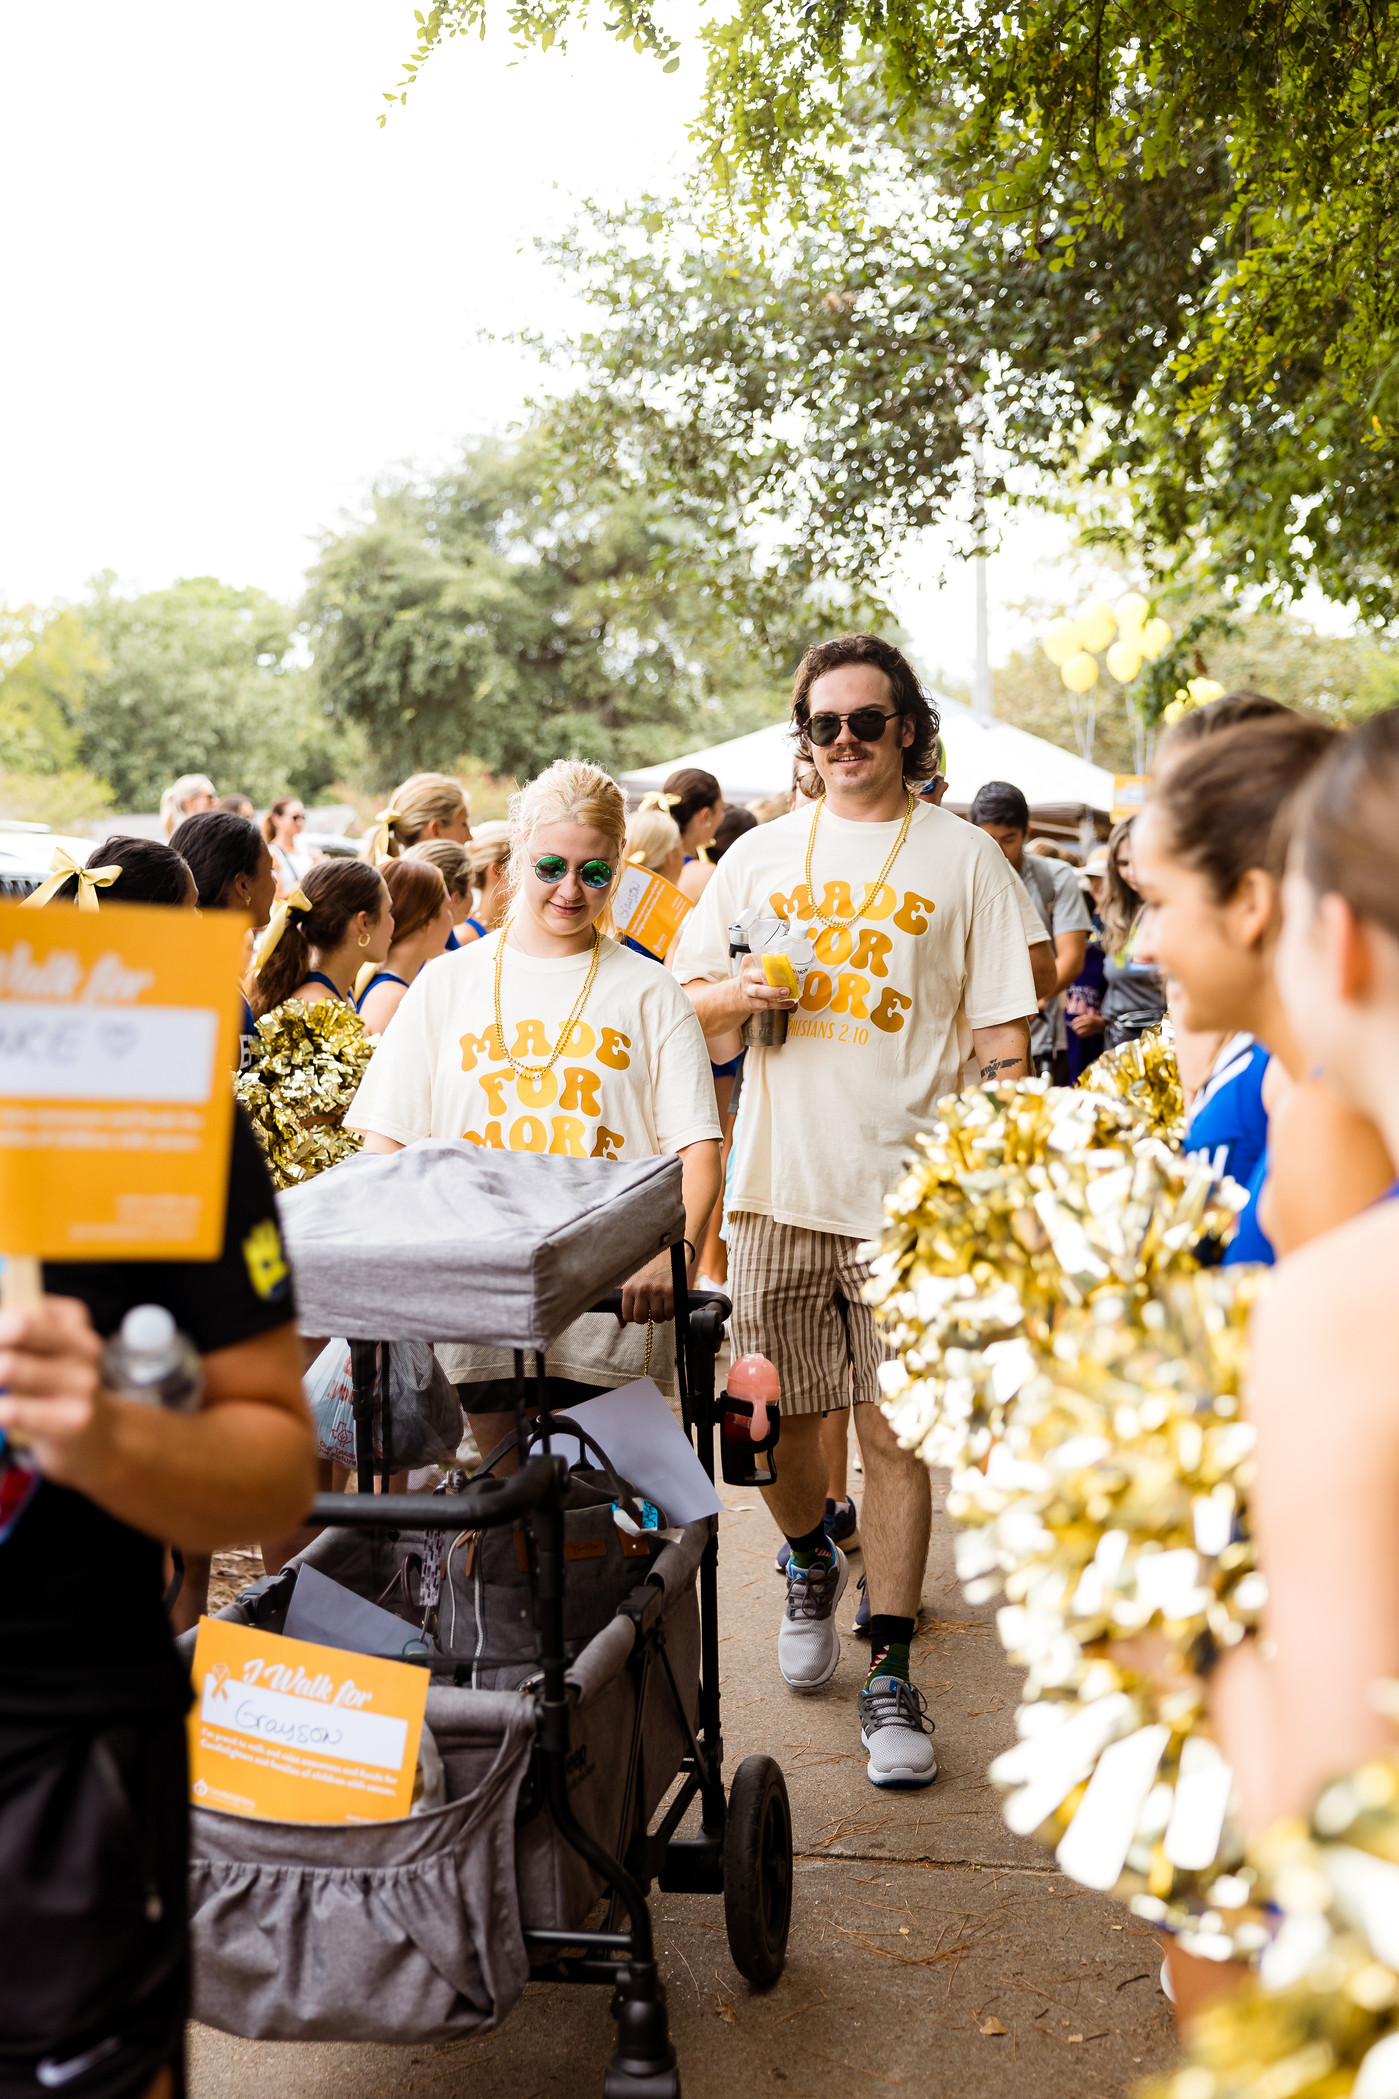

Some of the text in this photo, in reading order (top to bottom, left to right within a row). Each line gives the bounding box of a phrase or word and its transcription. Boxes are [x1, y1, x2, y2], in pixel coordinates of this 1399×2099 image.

[769, 880, 936, 936] MADE
[807, 926, 893, 978] OR
[788, 970, 913, 1033] ORE
[458, 1019, 632, 1072] MADE
[787, 1019, 870, 1046] PHESIANS 2:10
[478, 1064, 602, 1117] FOR
[243, 1658, 373, 1710] I Walk for
[215, 1733, 238, 1746] proud
[238, 1739, 248, 1749] to
[248, 1743, 265, 1755] walk
[266, 1748, 282, 1759] and
[342, 1767, 360, 1777] and
[360, 1768, 384, 1783] funds
[384, 1773, 399, 1786] for
[254, 1757, 270, 1768] and
[270, 1758, 301, 1777] families
[301, 1767, 313, 1778] of
[312, 1771, 346, 1787] children
[346, 1779, 366, 1791] with
